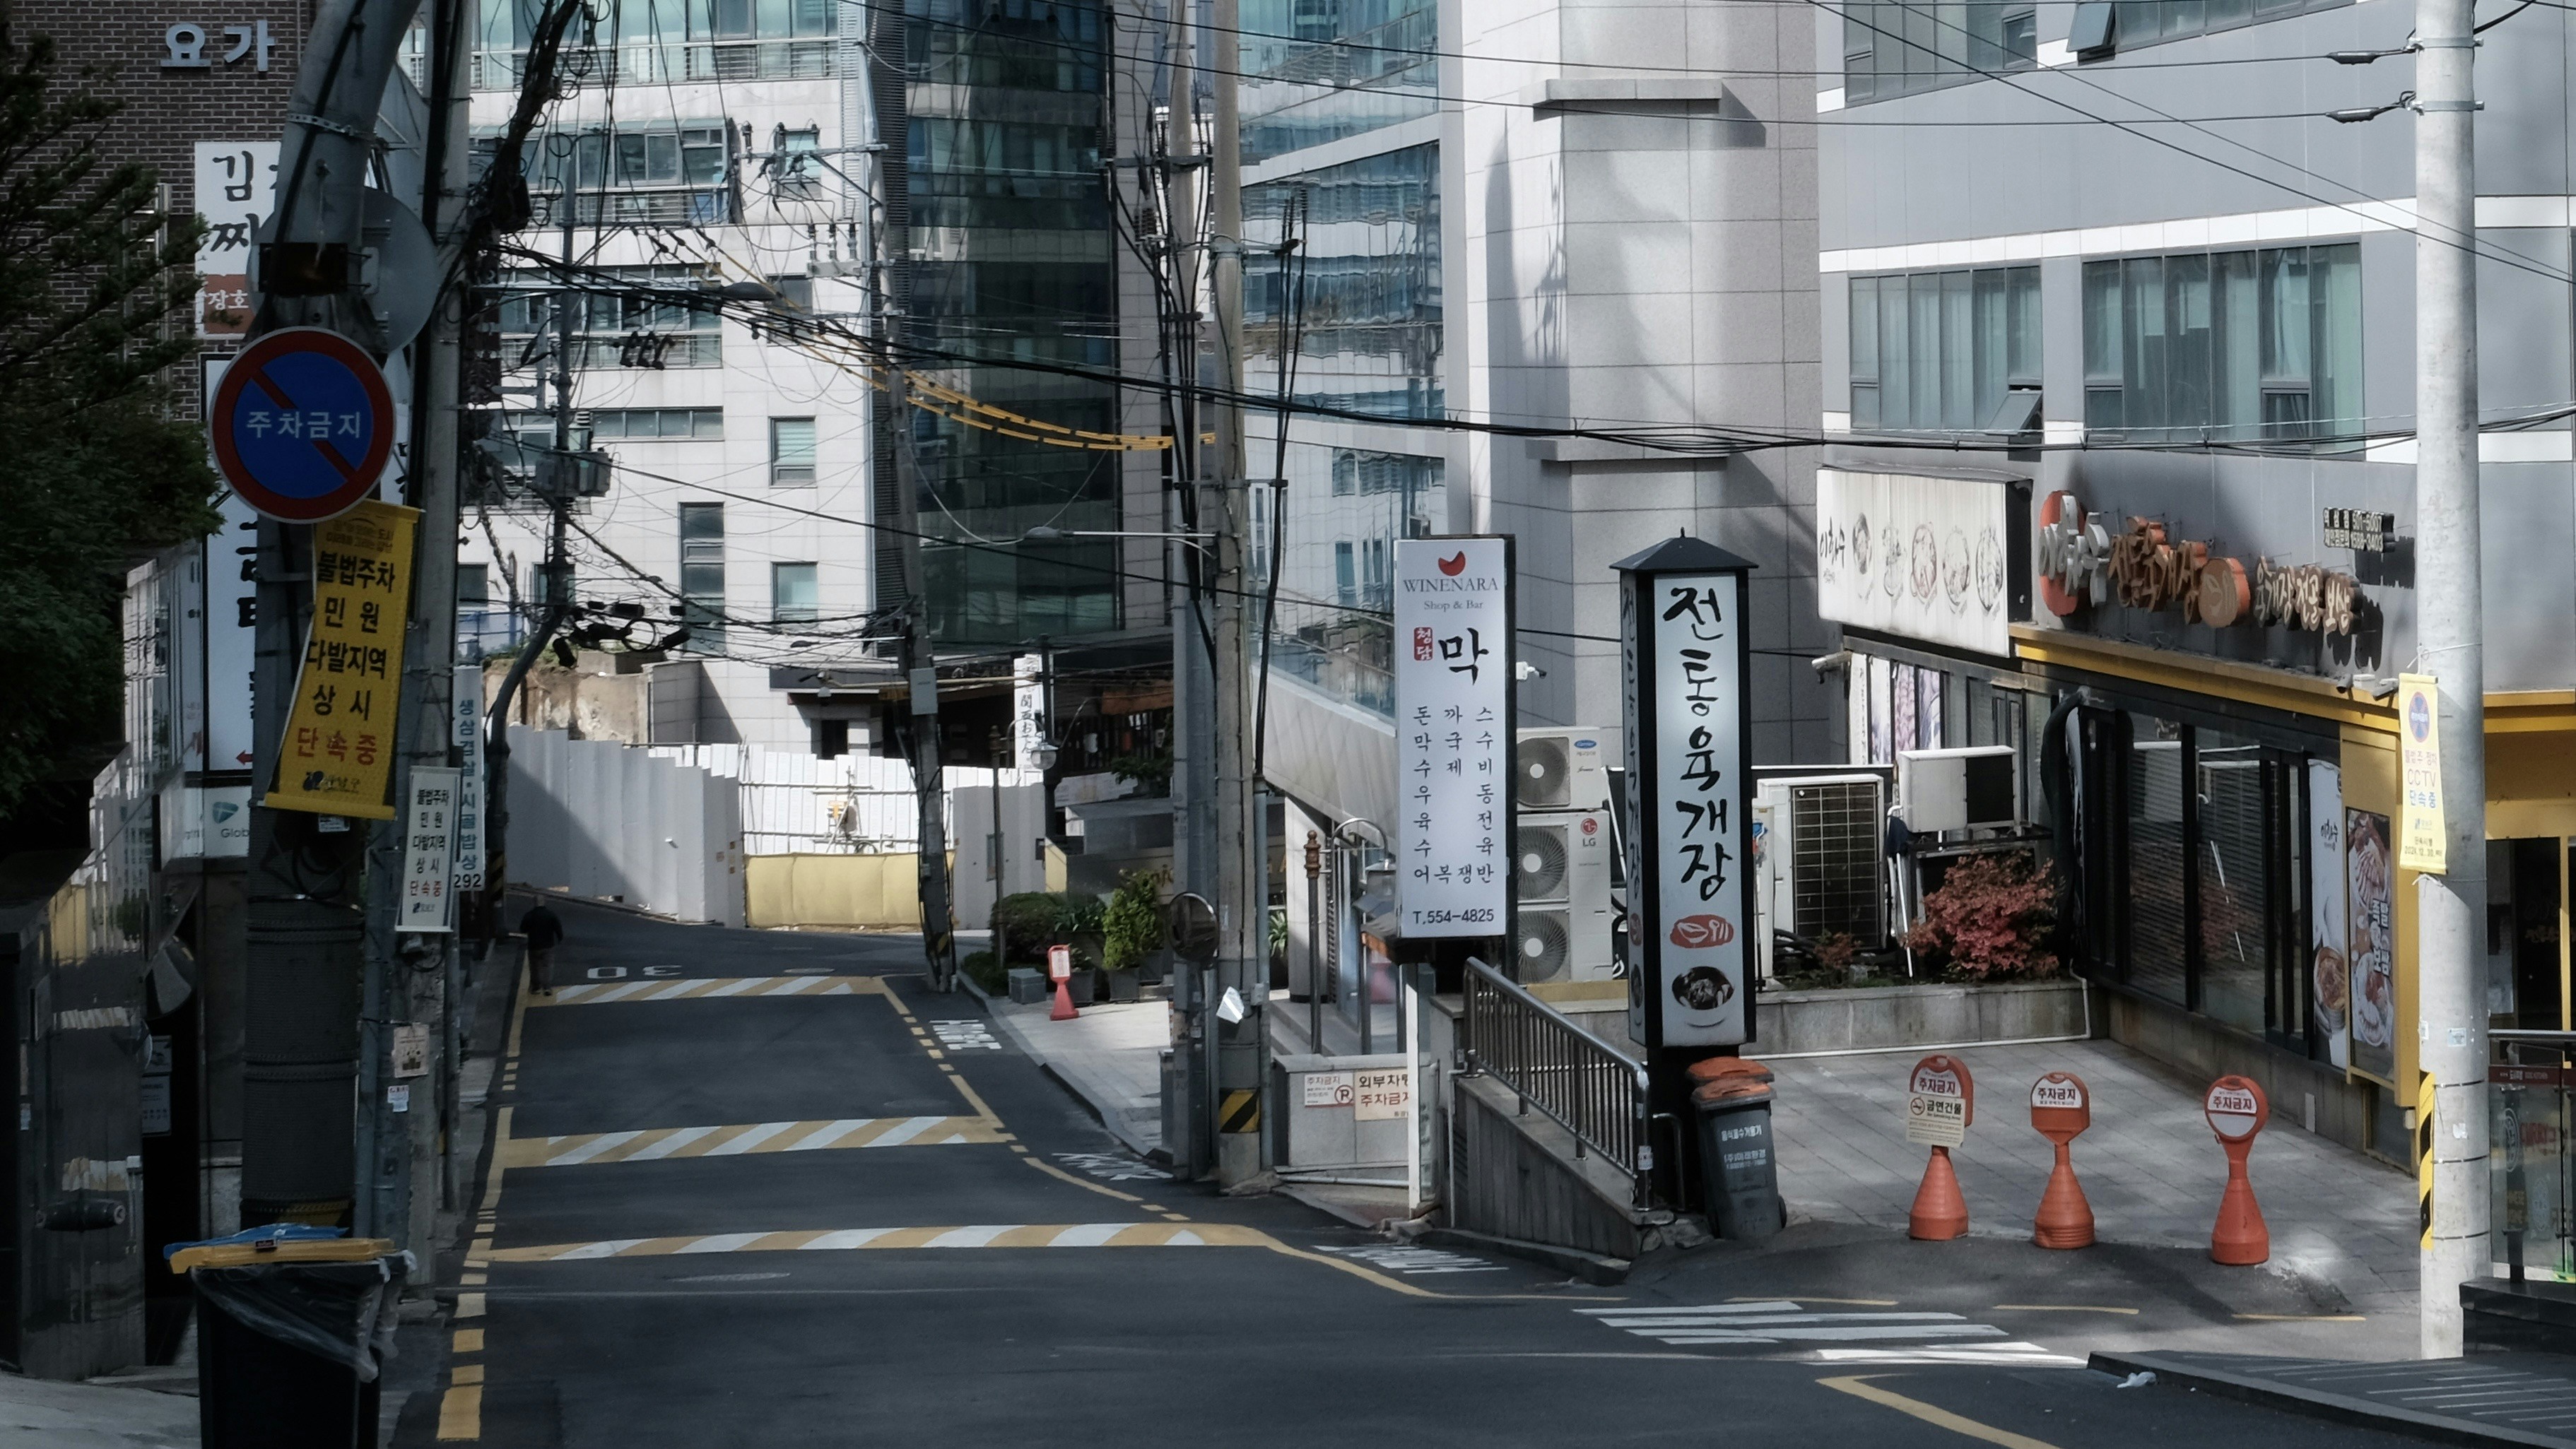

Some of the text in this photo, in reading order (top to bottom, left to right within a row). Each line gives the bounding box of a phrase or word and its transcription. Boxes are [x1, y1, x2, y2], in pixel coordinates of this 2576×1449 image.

[160, 20, 275, 71] 요가
[247, 410, 361, 439] 주차금지
[317, 550, 396, 593] 불법주차
[1403, 576, 1499, 593] WINENARA
[324, 597, 380, 634] 민원
[1423, 600, 1484, 613] Shop & Bar
[305, 640, 387, 680] 다발지역
[1437, 627, 1490, 686] 막
[312, 684, 371, 721] 상시
[1413, 704, 1494, 726] 돈까스
[297, 727, 378, 767] 단속중
[1413, 731, 1494, 752] 막국수
[1662, 587, 1734, 902] 전통육개장
[1413, 757, 1493, 779] 수제비
[2407, 769, 2437, 788] CCTV
[417, 788, 450, 806] 불법주차
[2409, 789, 2437, 809] 단속중
[1582, 838, 1596, 846] LG
[454, 873, 482, 888] 292
[1413, 908, 1495, 925] T.554-4825
[1919, 1077, 1956, 1096] 주차금지
[2037, 1087, 2076, 1101] 주차금지
[1927, 1099, 1962, 1116] 금연건물
[2213, 1096, 2252, 1111] 주차금지
